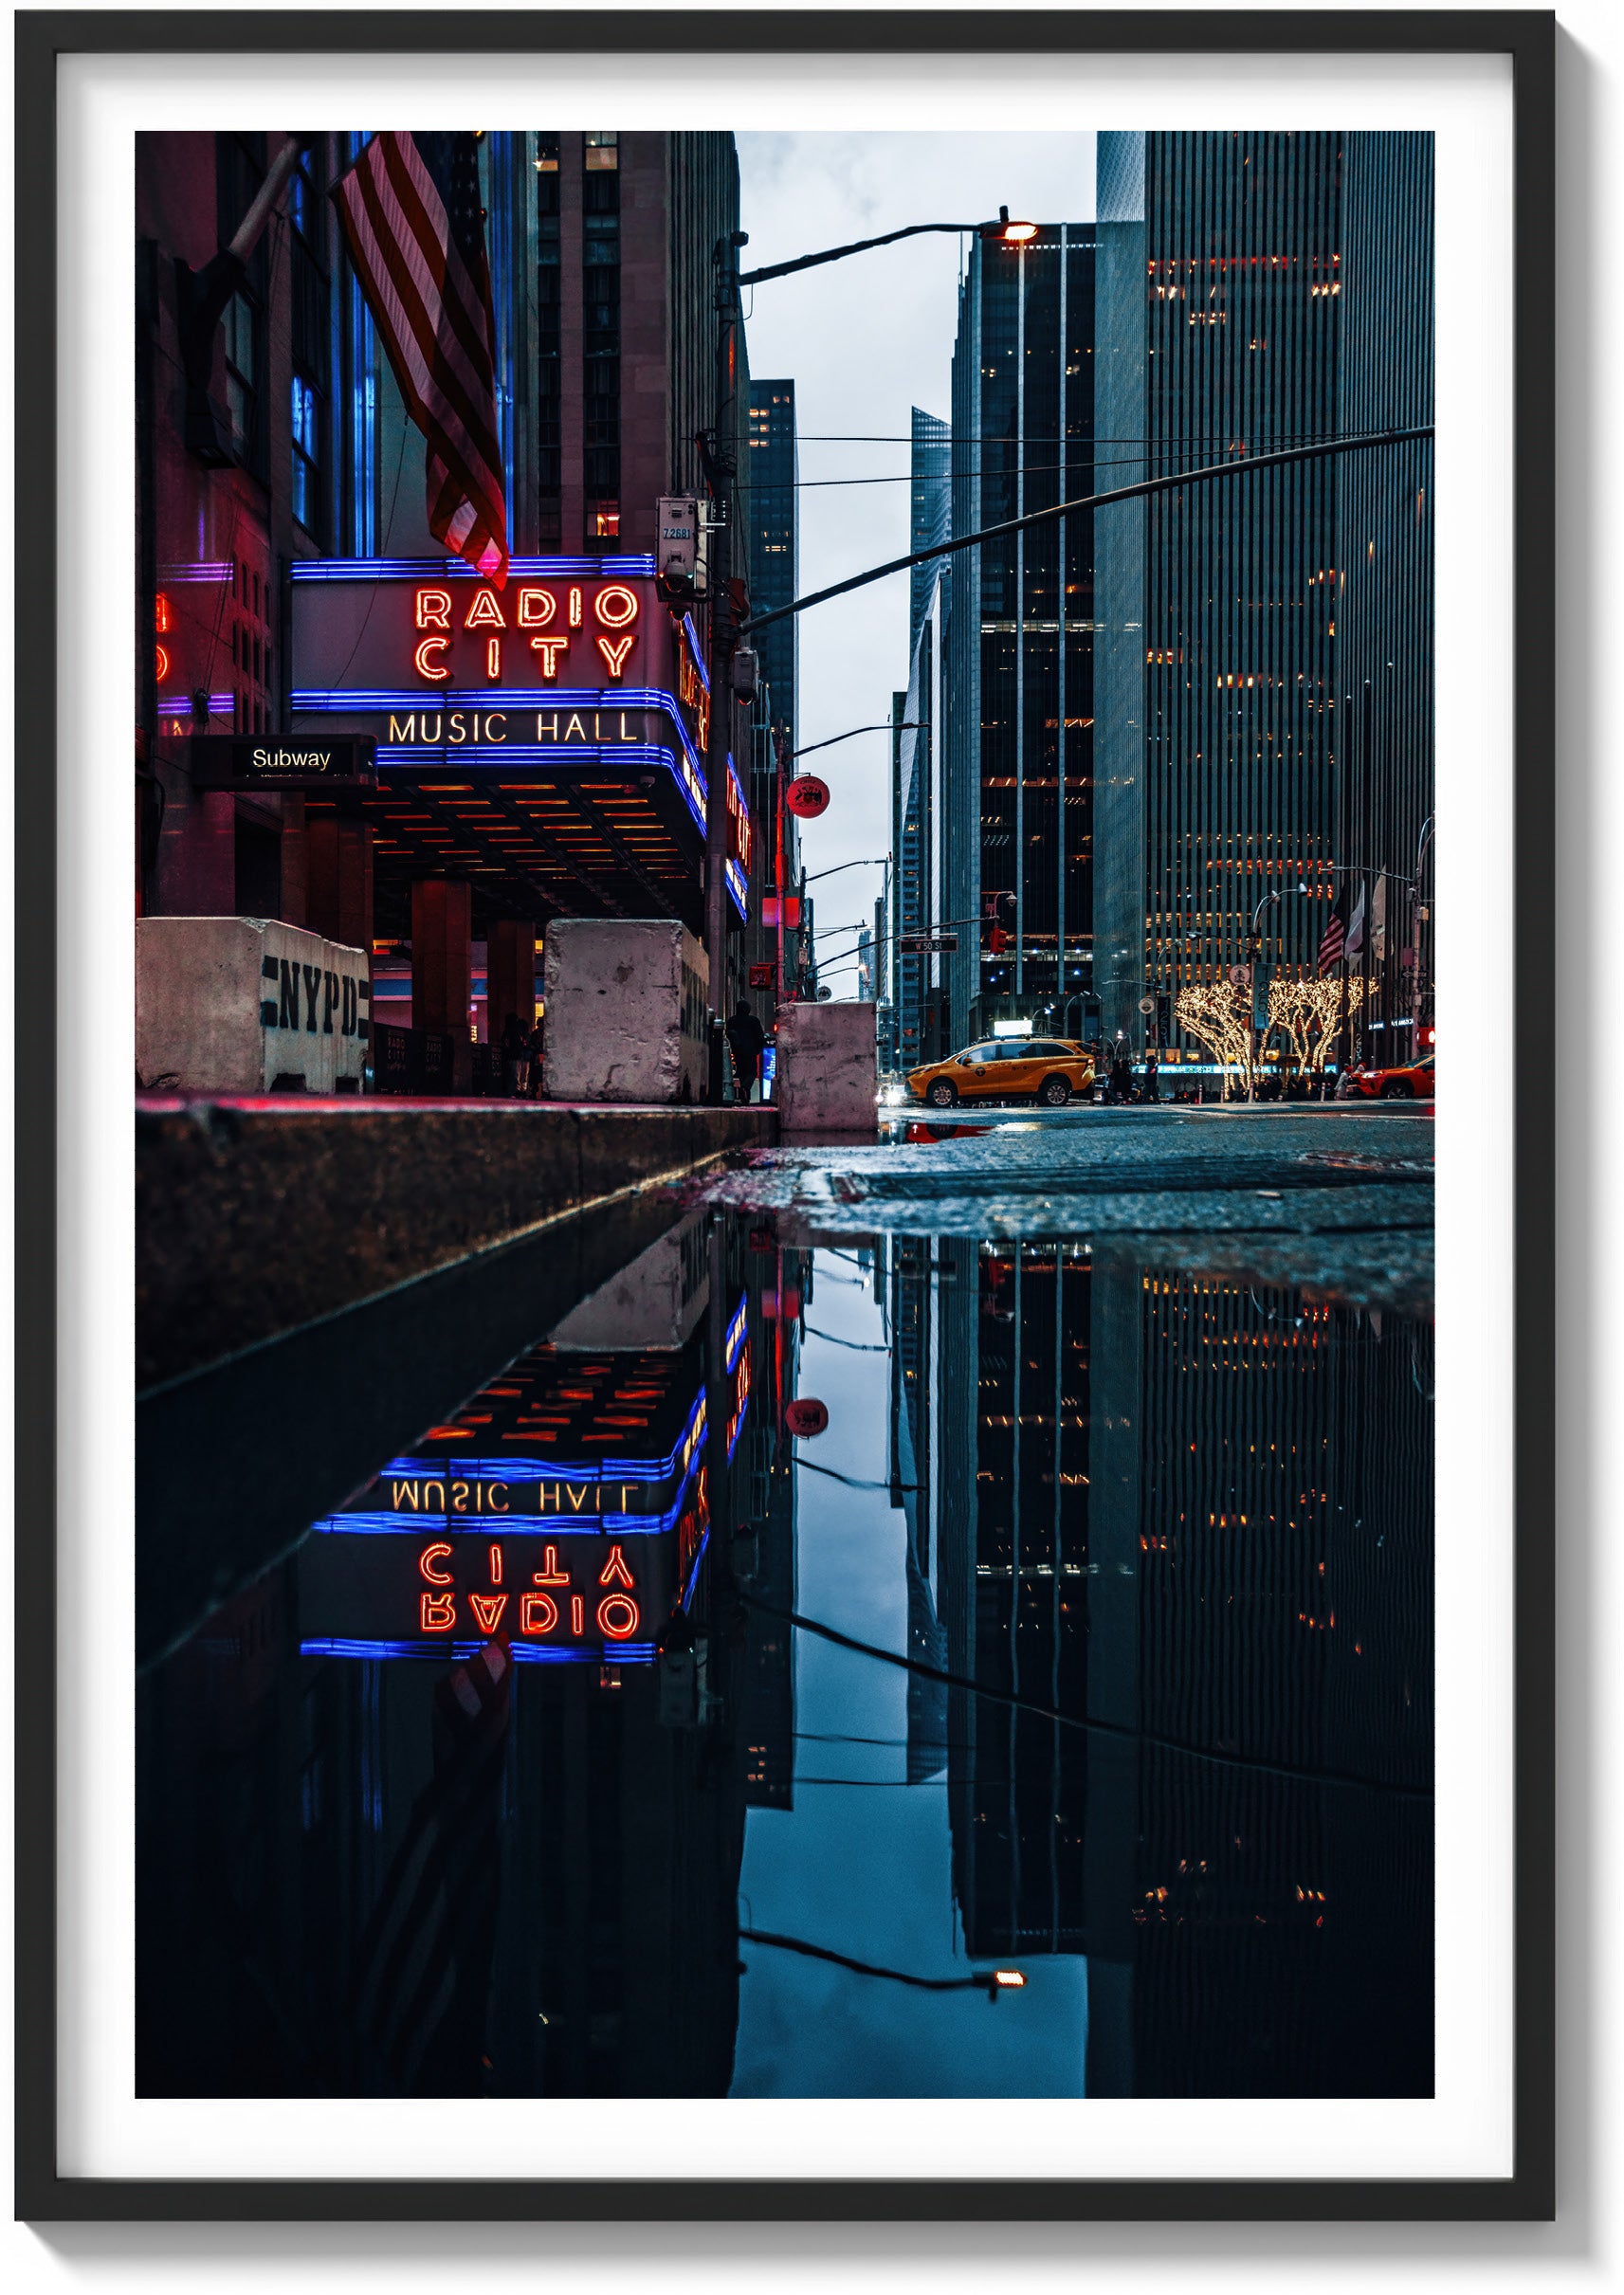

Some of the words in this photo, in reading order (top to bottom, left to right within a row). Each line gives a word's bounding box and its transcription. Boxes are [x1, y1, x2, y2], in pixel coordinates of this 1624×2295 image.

[414, 584, 639, 630] RADIO
[414, 635, 637, 681] CITY
[389, 713, 508, 743] MUSIC
[537, 713, 638, 742] HALL
[252, 748, 331, 772] Subway
[923, 941, 933, 950] 50
[935, 941, 942, 950] St
[280, 958, 357, 1036] NYPD
[1257, 967, 1269, 1028] 1251
